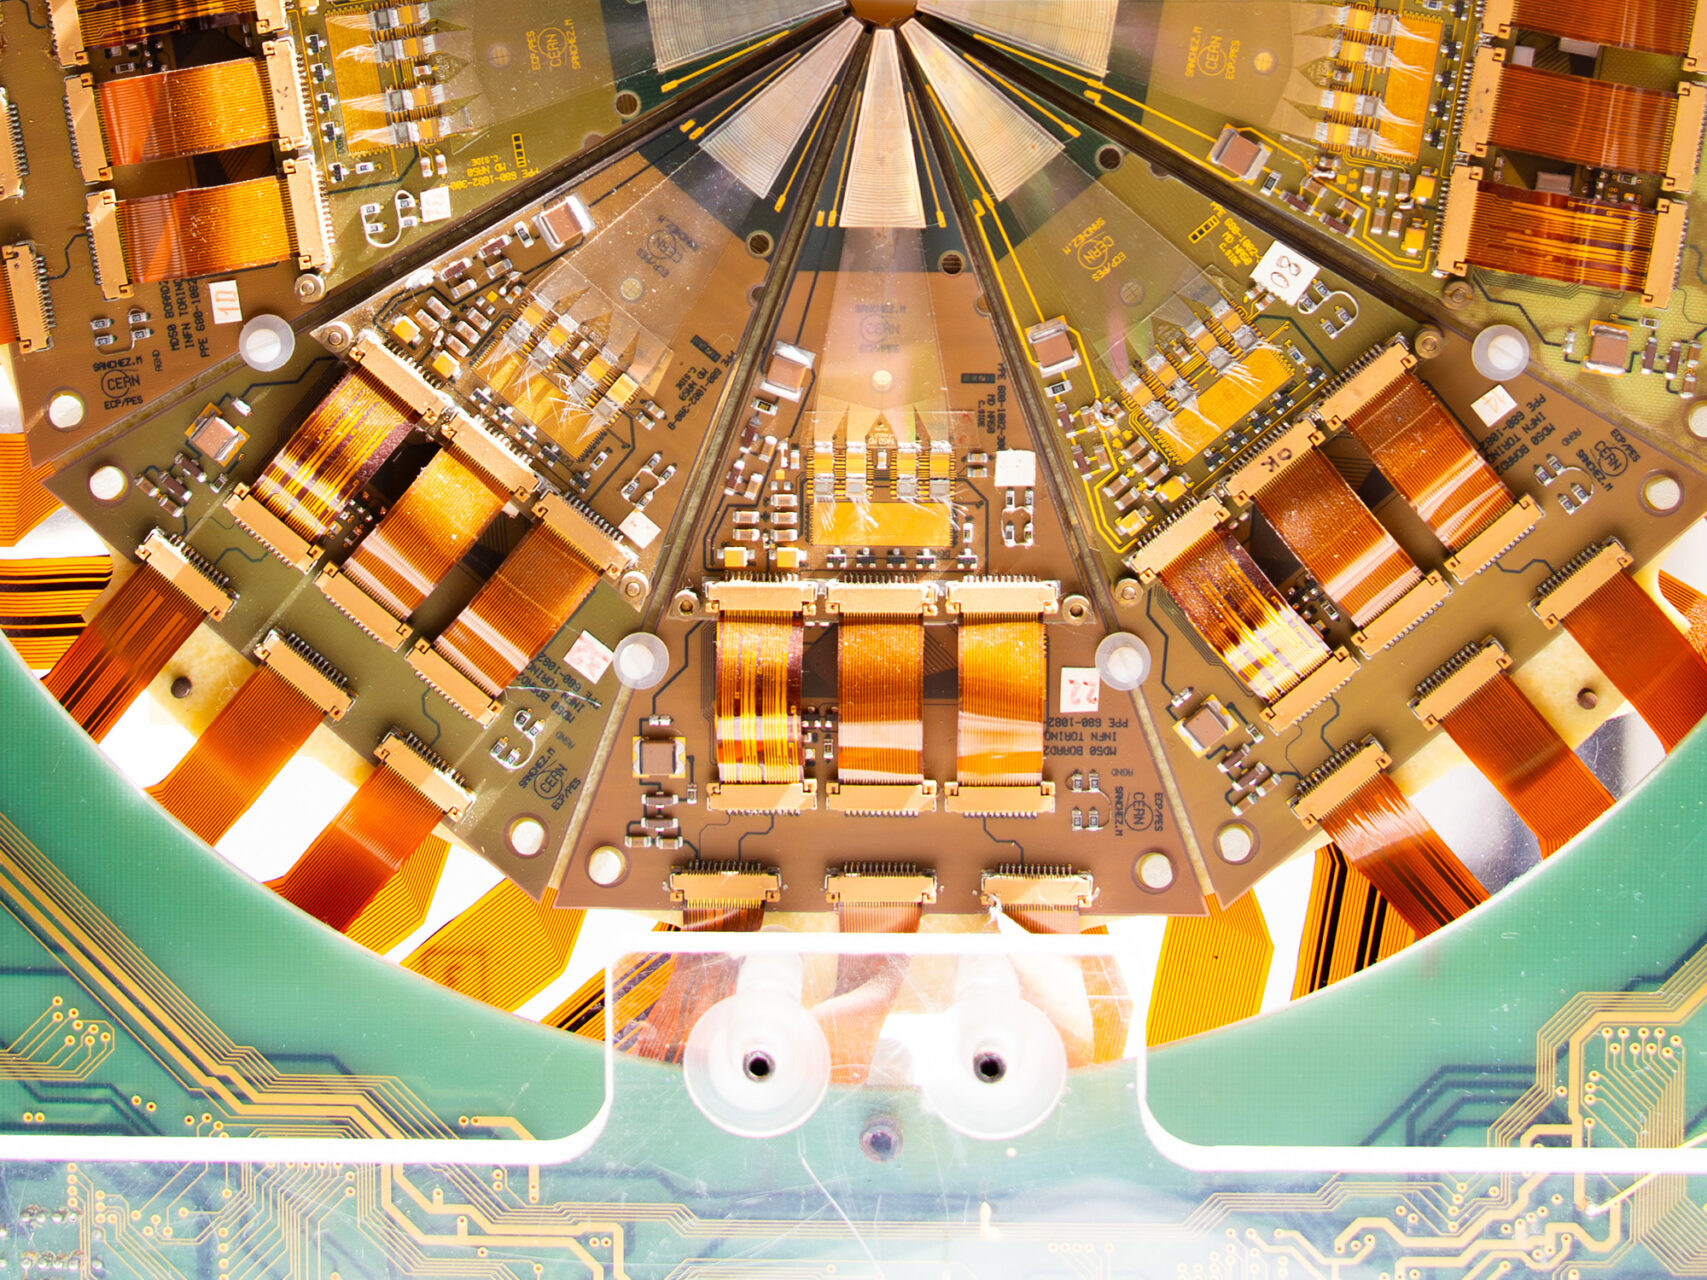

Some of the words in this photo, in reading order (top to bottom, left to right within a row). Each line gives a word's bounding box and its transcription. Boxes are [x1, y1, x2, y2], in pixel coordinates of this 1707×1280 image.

[544, 33, 560, 66] CERN
[1205, 35, 1222, 70] CERN
[493, 162, 506, 171] MD
[651, 235, 683, 263] CERN
[1082, 234, 1114, 264] CERN
[1220, 230, 1234, 245] MD
[1263, 251, 1304, 292] 80
[158, 279, 174, 318] BOARD2
[213, 287, 240, 316] 10
[166, 323, 180, 351] MD50
[180, 322, 194, 348] INFN
[197, 336, 210, 357] PPE
[106, 373, 140, 390] CERN
[1479, 386, 1509, 416] 14
[1525, 393, 1546, 412] PPE
[1520, 410, 1545, 434] INFN
[1528, 421, 1555, 446] MD50
[1260, 443, 1293, 475] OK
[1483, 432, 1520, 464] TORINO
[1493, 443, 1530, 476] BOARD2
[1593, 439, 1623, 471] CERN
[515, 670, 550, 702] BOARD2
[559, 689, 585, 712] INFN
[1043, 731, 1082, 741] TORINO
[1090, 731, 1116, 741] INFN
[1108, 717, 1127, 727] PPE
[1043, 745, 1082, 755] BOARD2
[538, 762, 568, 794] CERN
[1133, 792, 1144, 824] CERN
